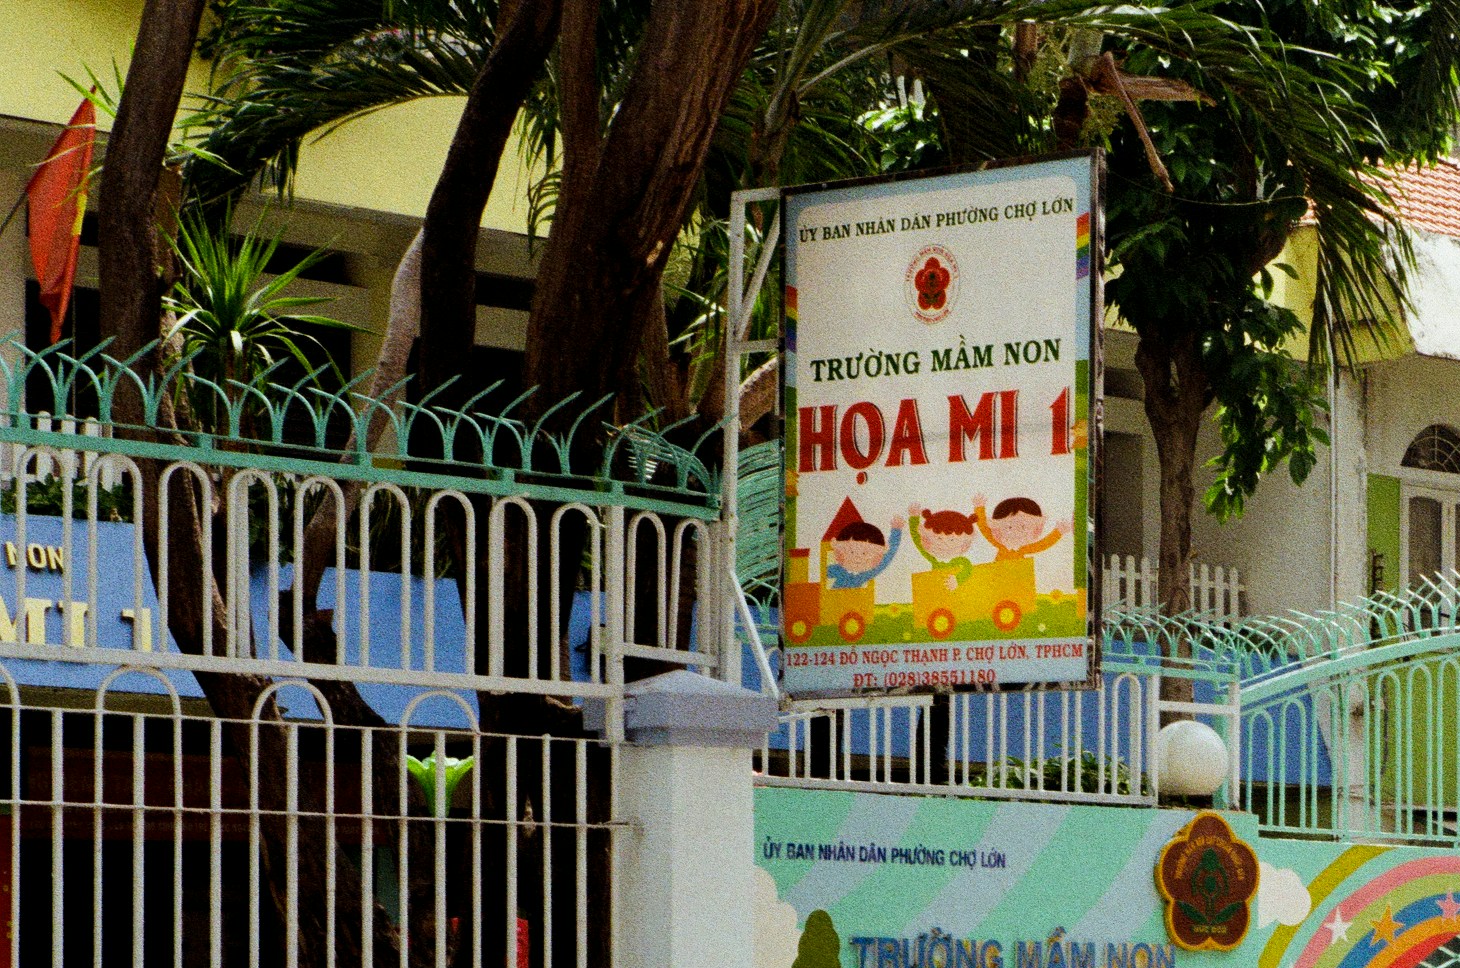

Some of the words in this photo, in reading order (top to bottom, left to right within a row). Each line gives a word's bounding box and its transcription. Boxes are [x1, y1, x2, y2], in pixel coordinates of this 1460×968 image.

[799, 225, 818, 242] ỦY
[822, 223, 851, 240] BAN
[855, 217, 896, 236] NHÂN
[901, 213, 931, 231] DÂN
[935, 206, 999, 227] PHƯỜNG
[1004, 201, 1037, 221] CHỢ
[1042, 195, 1074, 215] LỚN
[810, 347, 921, 382] TRƯỜNG
[931, 334, 994, 372] MẦM
[1004, 338, 1062, 366] NON
[797, 398, 930, 486] HỌA
[947, 389, 1020, 463] MI
[1049, 386, 1072, 456] 1
[786, 652, 836, 667] 122-124
[862, 650, 899, 668] NGỌC
[903, 648, 948, 666] THẠNH
[966, 645, 995, 664] CHỢ
[1035, 643, 1084, 659] TPHCM
[853, 673, 878, 688] ĐT:
[884, 669, 996, 688] (028)38551180
[763, 836, 783, 860] ỦY
[786, 843, 815, 860] BAN
[819, 840, 856, 861] NHÂN
[859, 842, 887, 863] DÂN
[891, 843, 945, 866] PHƯỜNG
[949, 848, 977, 870] CHỢ
[981, 846, 1006, 868] LỚN
